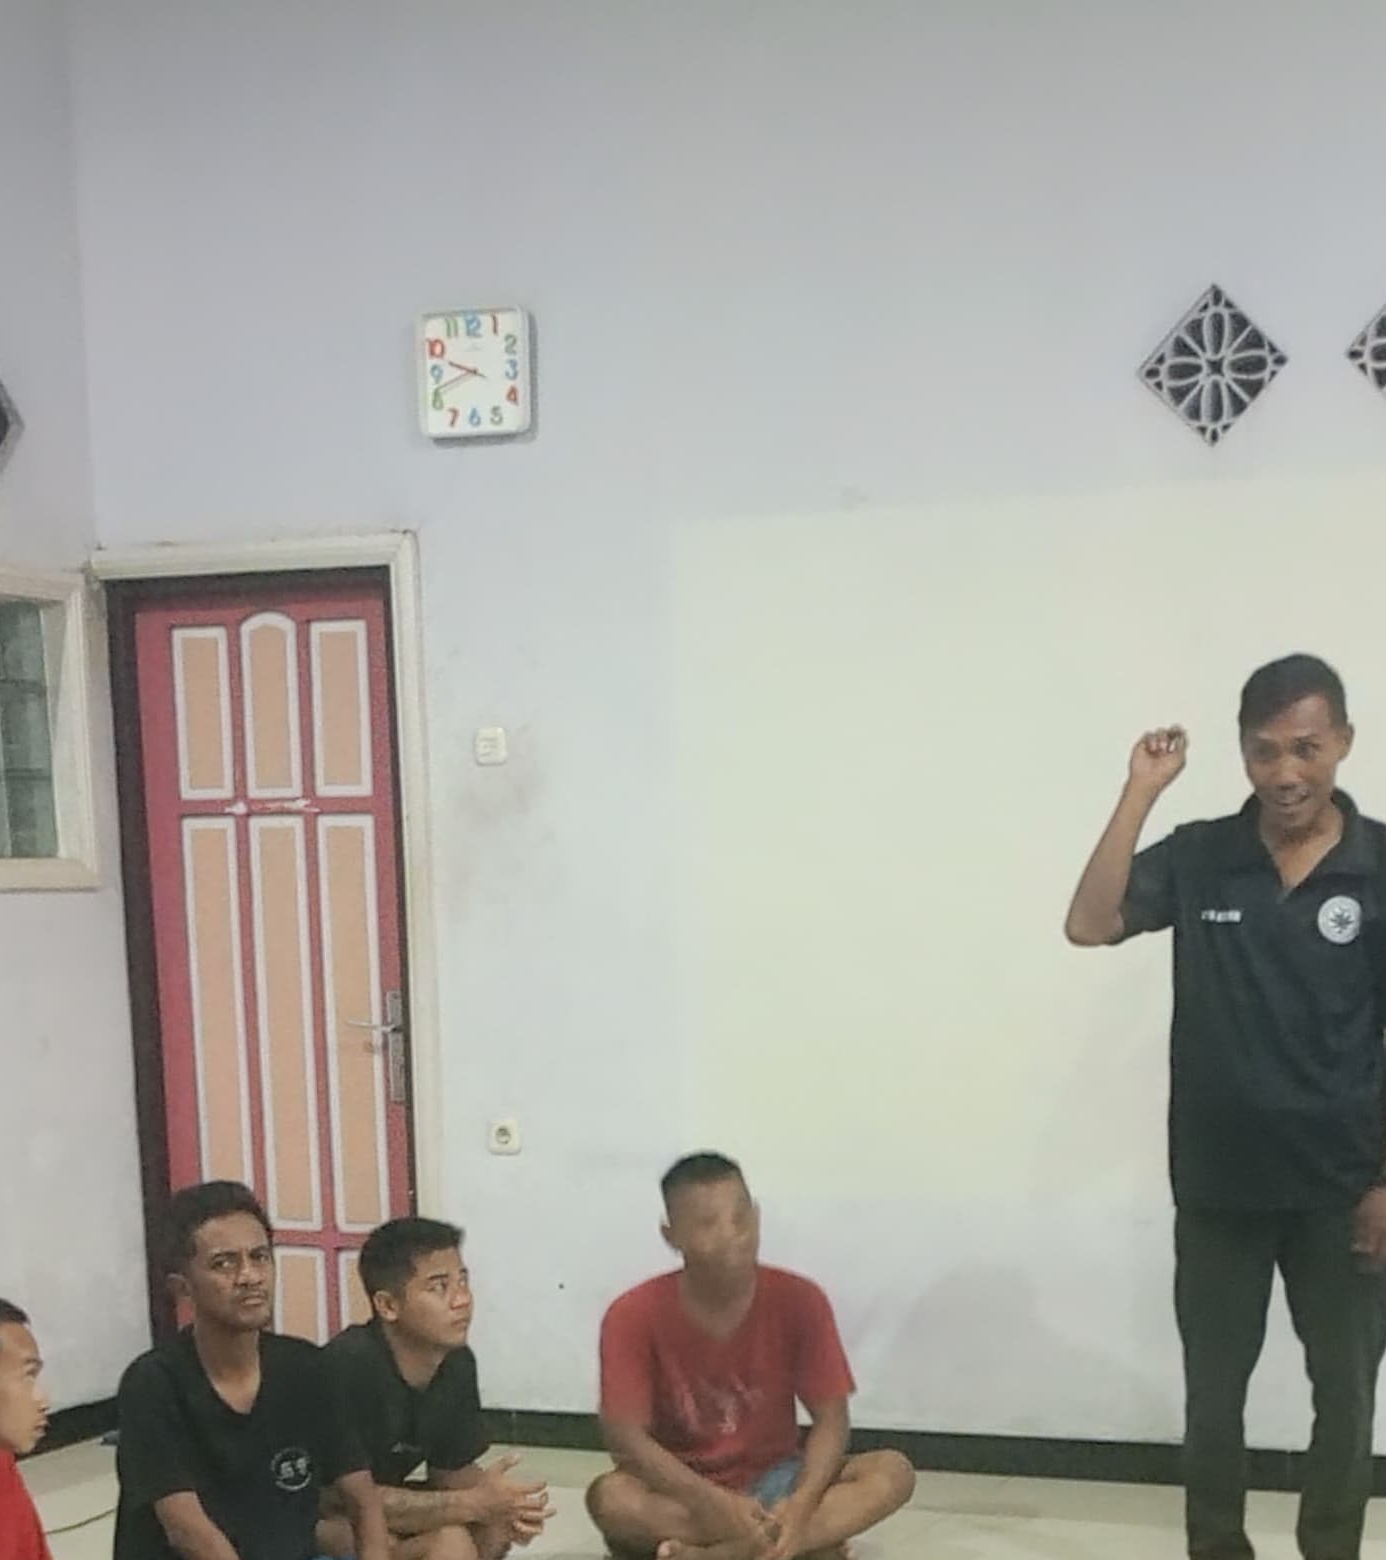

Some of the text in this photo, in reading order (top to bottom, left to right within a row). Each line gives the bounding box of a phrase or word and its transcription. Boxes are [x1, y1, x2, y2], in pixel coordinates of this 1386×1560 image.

[445, 318, 459, 338] 11
[465, 312, 482, 338] 12
[491, 313, 499, 336] 1
[426, 338, 445, 359] 10
[504, 333, 518, 355] 2
[430, 364, 444, 384] 9
[505, 359, 518, 380] 3
[432, 389, 444, 410] 8
[506, 386, 519, 406] 4
[447, 408, 460, 427] 7
[469, 407, 481, 427] 6
[490, 406, 504, 425] 5
